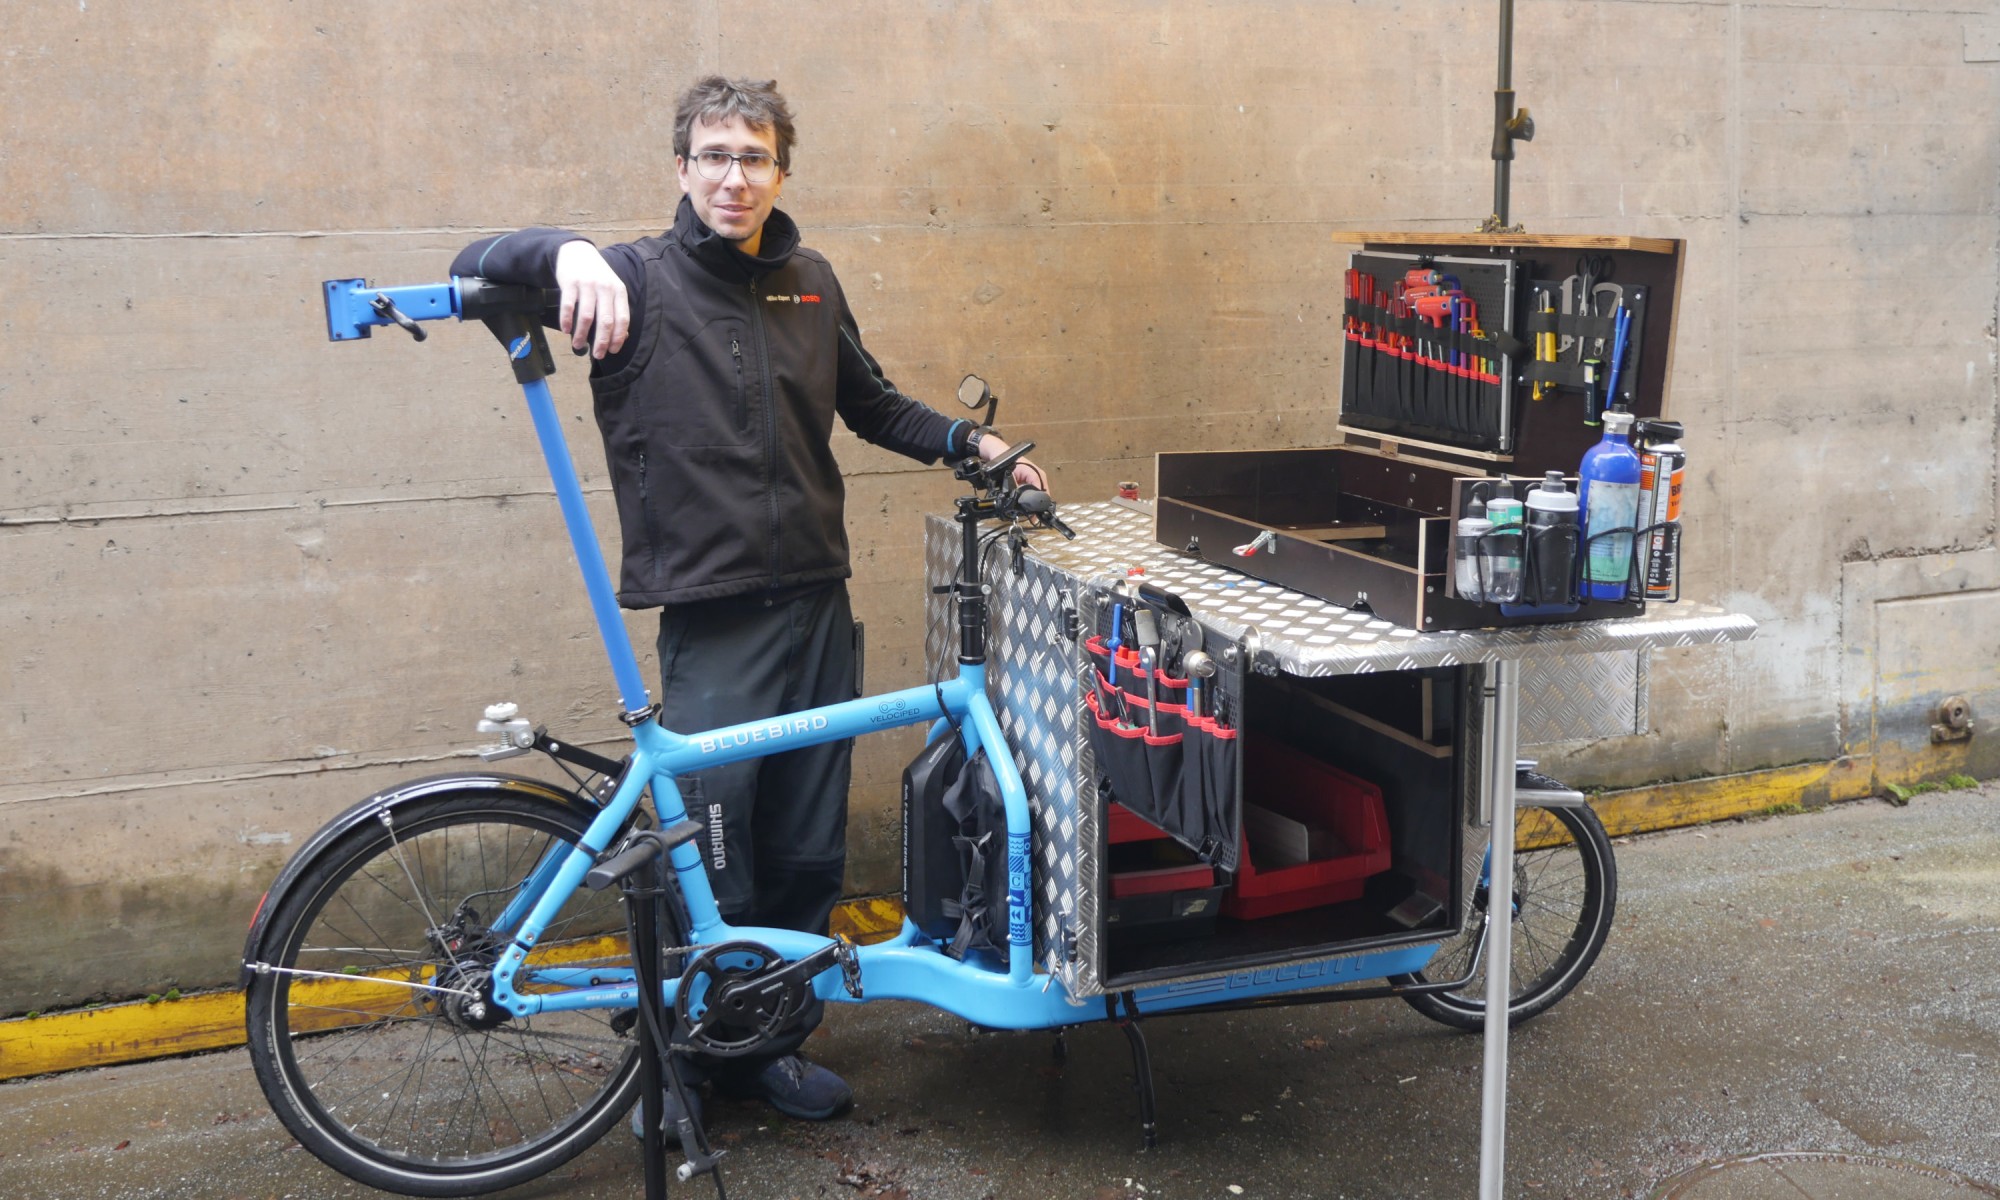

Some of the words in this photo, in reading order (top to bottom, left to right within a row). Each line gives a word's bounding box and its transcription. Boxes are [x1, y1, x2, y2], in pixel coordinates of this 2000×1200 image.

[700, 715, 829, 754] BLUEBIRD
[870, 707, 920, 724] VELOCIPED
[709, 803, 726, 871] SHIMANO
